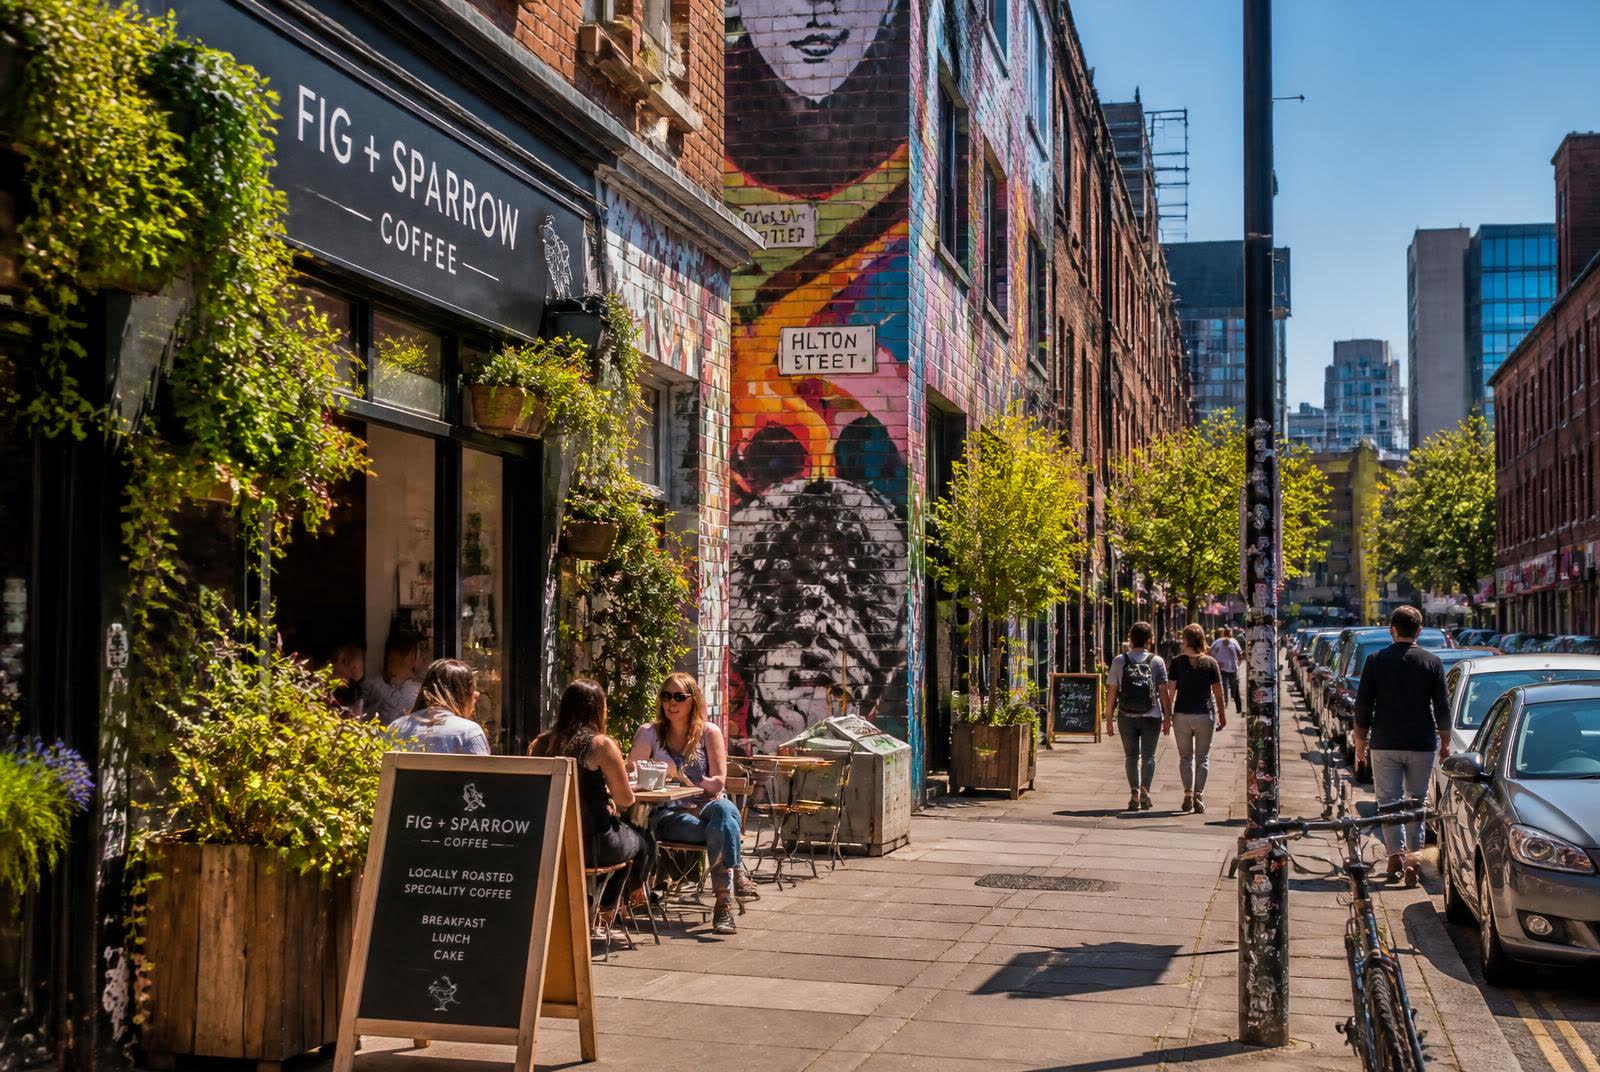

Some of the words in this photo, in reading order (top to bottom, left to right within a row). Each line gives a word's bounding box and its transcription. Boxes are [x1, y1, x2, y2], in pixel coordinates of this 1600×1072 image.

[297, 84, 352, 164] FIG
[364, 135, 380, 173] +
[391, 140, 519, 250] SPARROW
[381, 212, 457, 275] COFFEE
[405, 815, 433, 829] FIG
[437, 819, 446, 828] +
[450, 817, 531, 834] SPARROW
[444, 837, 489, 849] COFFEE
[408, 868, 458, 880] LOCALLY
[461, 870, 514, 883] ROASTED
[404, 884, 466, 897] SPECIALITY
[469, 887, 512, 900] COFFEE
[421, 914, 486, 928] BREAKFAST
[431, 932, 471, 944] LUNCH
[433, 949, 465, 961] CAKE
